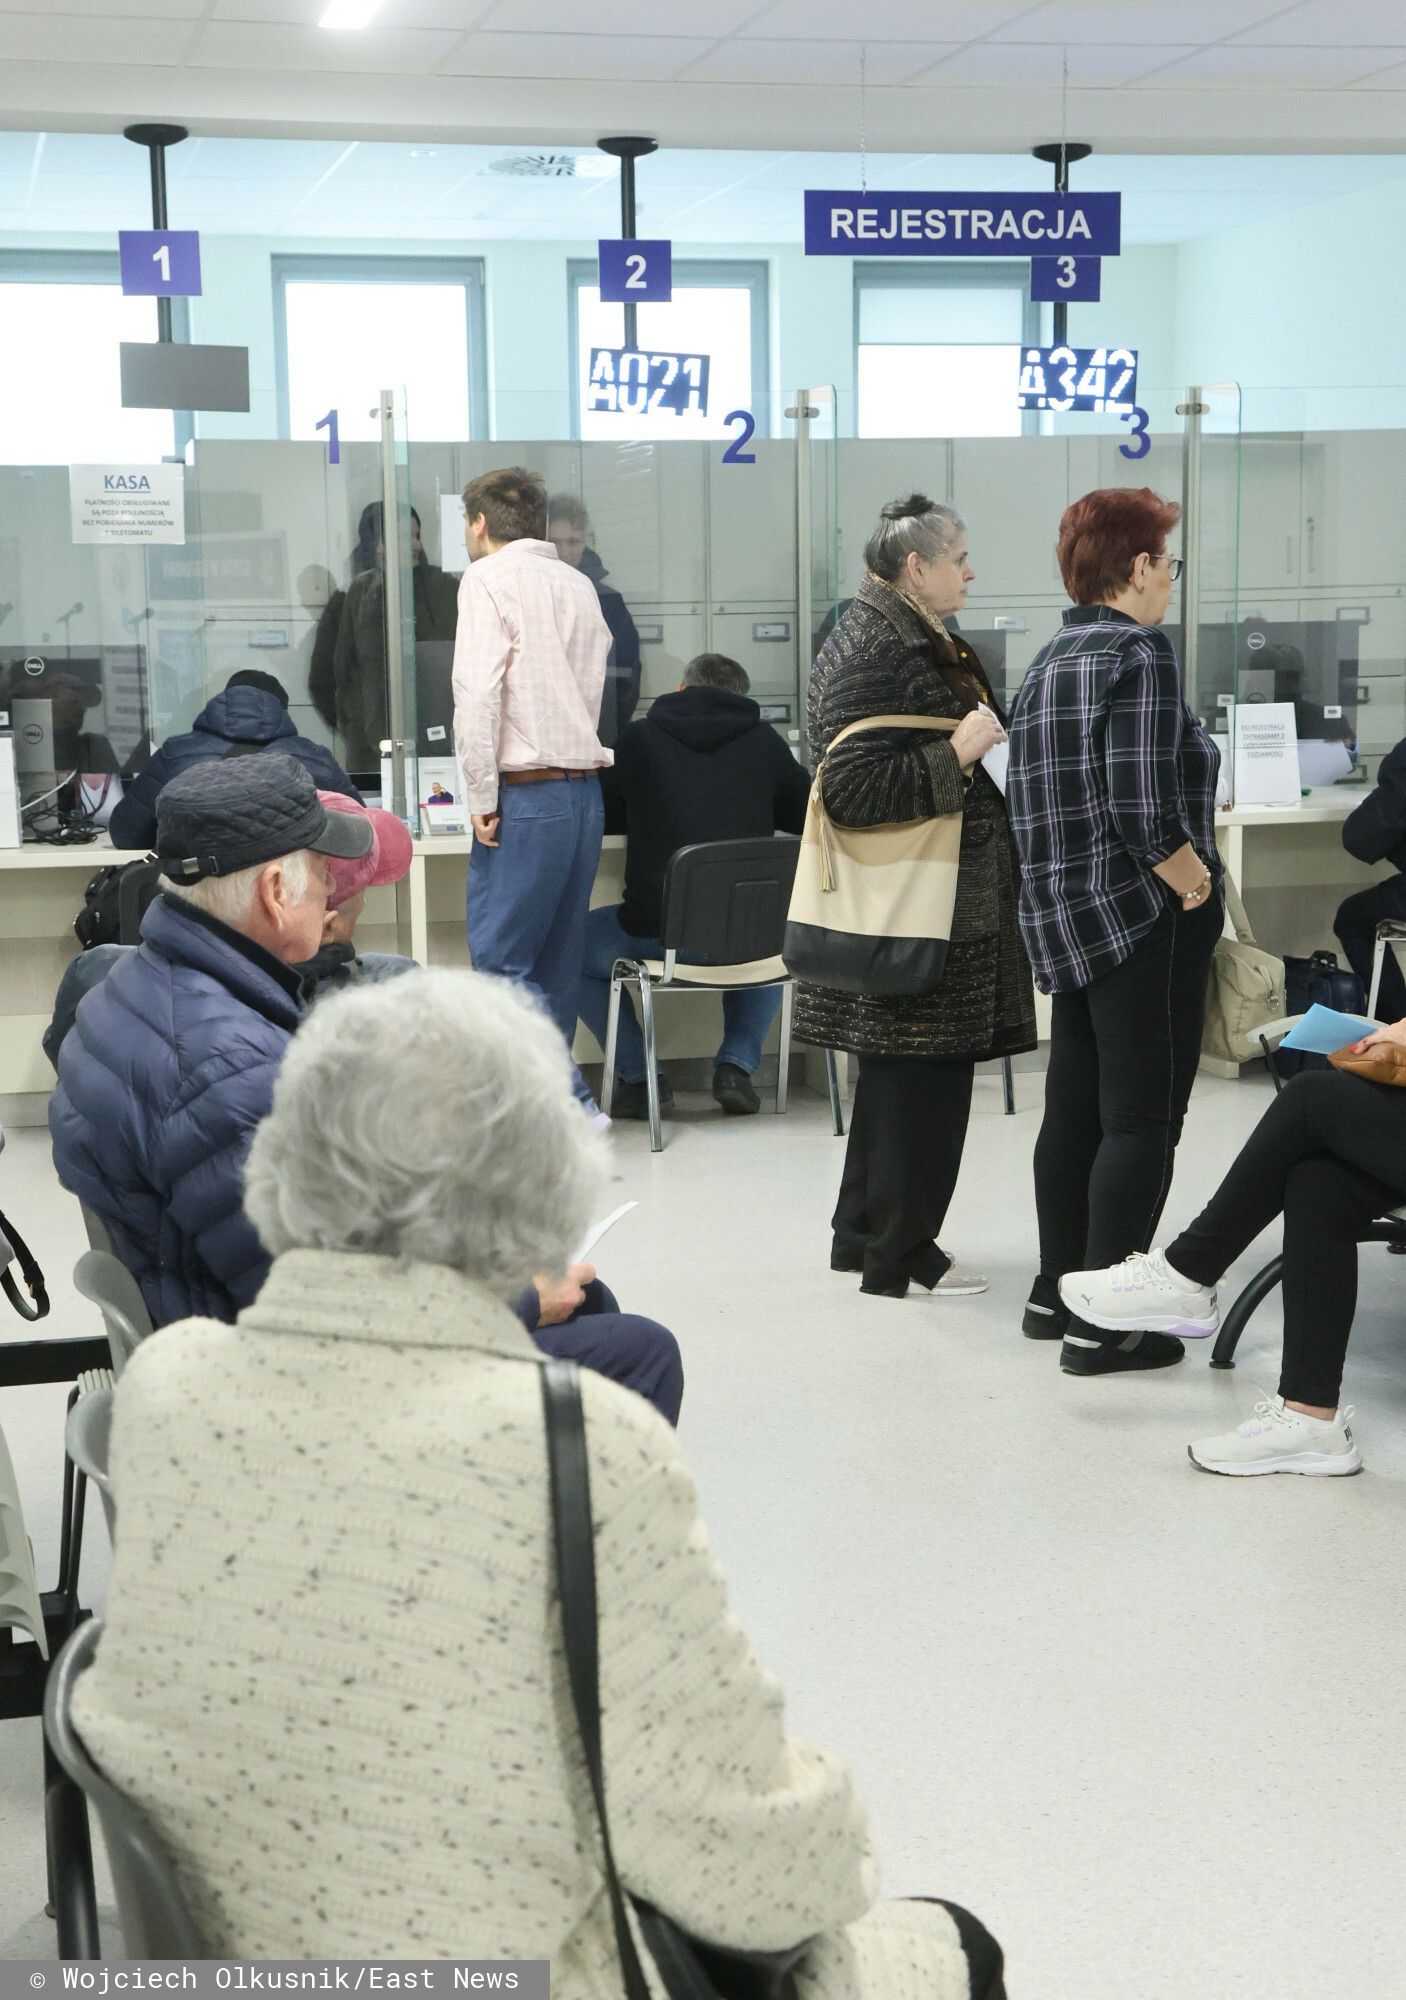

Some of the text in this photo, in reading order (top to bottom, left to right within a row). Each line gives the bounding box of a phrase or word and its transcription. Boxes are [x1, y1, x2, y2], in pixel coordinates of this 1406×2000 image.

[830, 208, 1092, 240] REJESTRACJA
[152, 245, 171, 281] 1
[625, 254, 647, 289] 2
[1056, 256, 1077, 288] 3
[588, 350, 704, 417] A021
[1017, 346, 1136, 414] A342
[315, 409, 340, 464] 1
[721, 410, 756, 464] 2
[1119, 406, 1151, 459] 3
[104, 475, 150, 489] KASA
